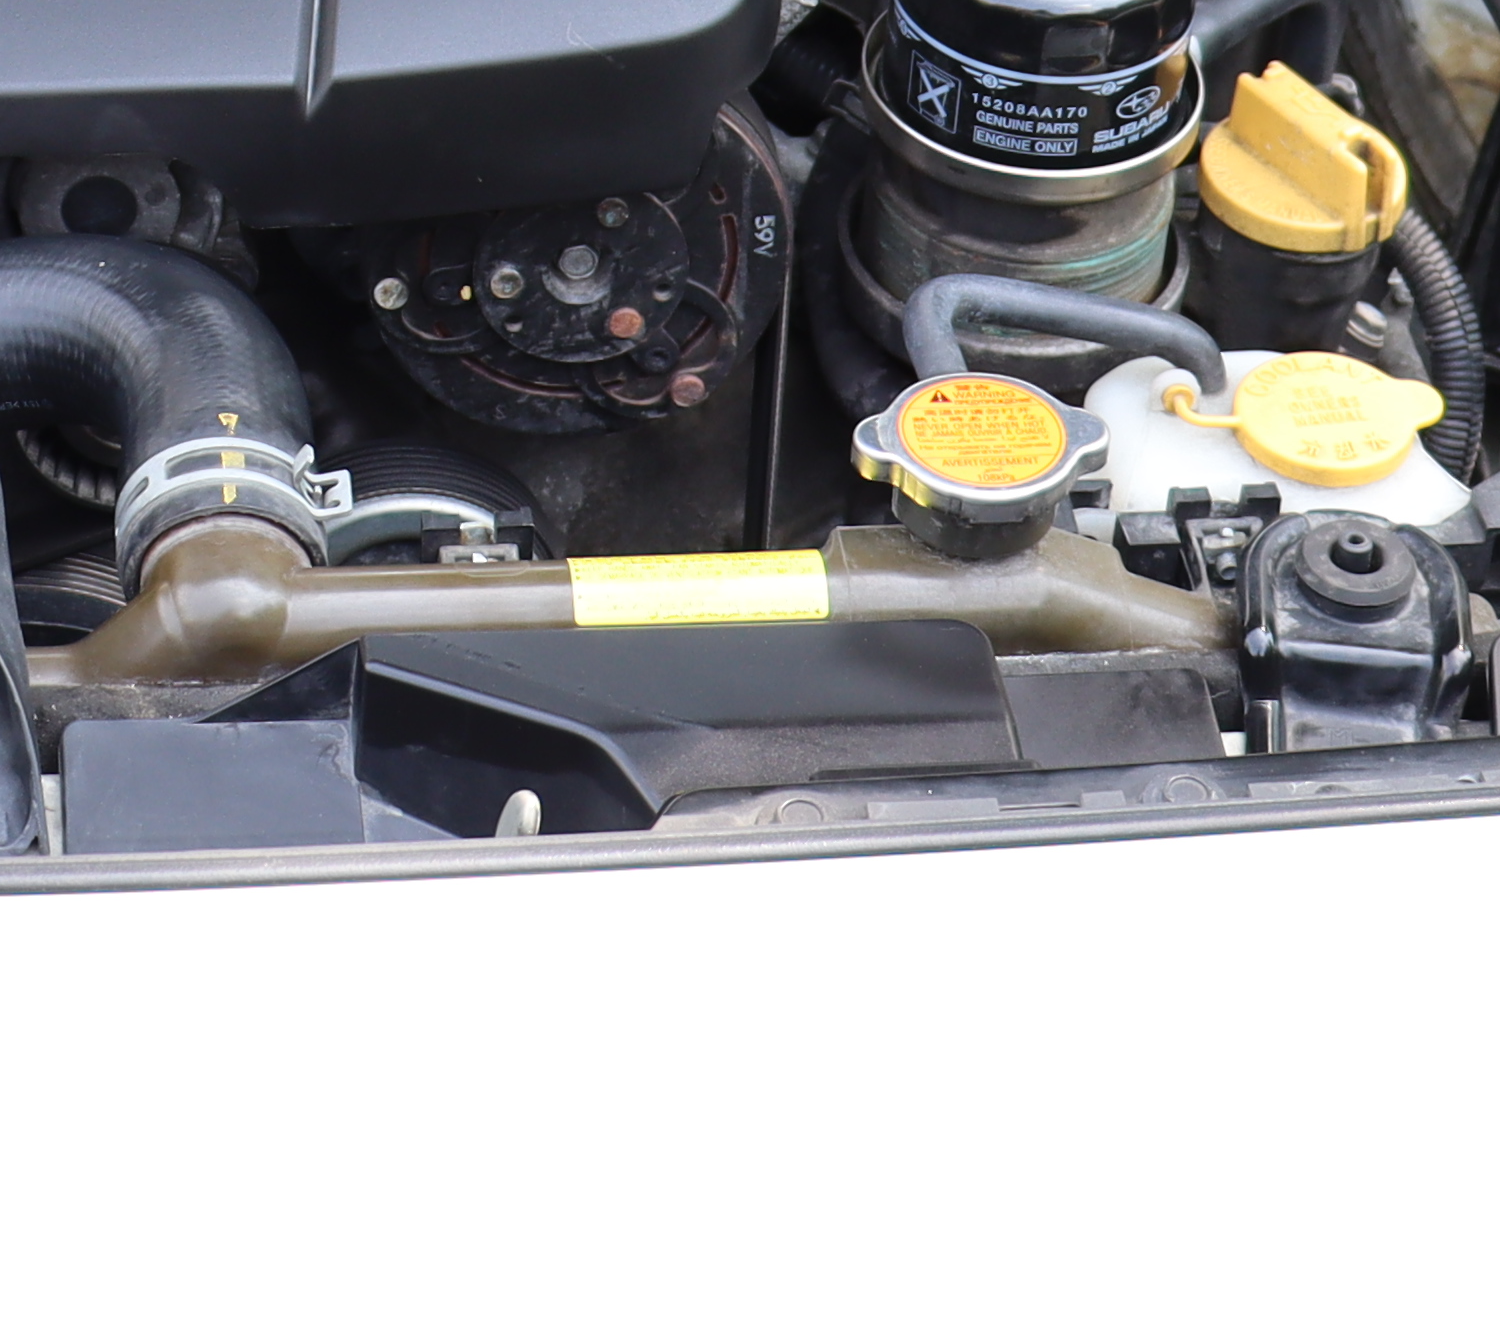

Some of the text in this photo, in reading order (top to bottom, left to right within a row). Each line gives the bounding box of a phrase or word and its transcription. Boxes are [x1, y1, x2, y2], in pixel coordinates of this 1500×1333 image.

[971, 92, 1088, 119] 15208AA170
[976, 109, 1079, 134] GENUINE PARTS
[1093, 102, 1170, 144] SUBARU
[976, 131, 1074, 153] ENGINE ONLY
[1092, 137, 1125, 153] MADE
[952, 390, 1016, 398] WARNING
[913, 423, 949, 431] NEVER
[1293, 410, 1368, 427] MANUAL
[942, 457, 1040, 467] AVERTISSEMENT
